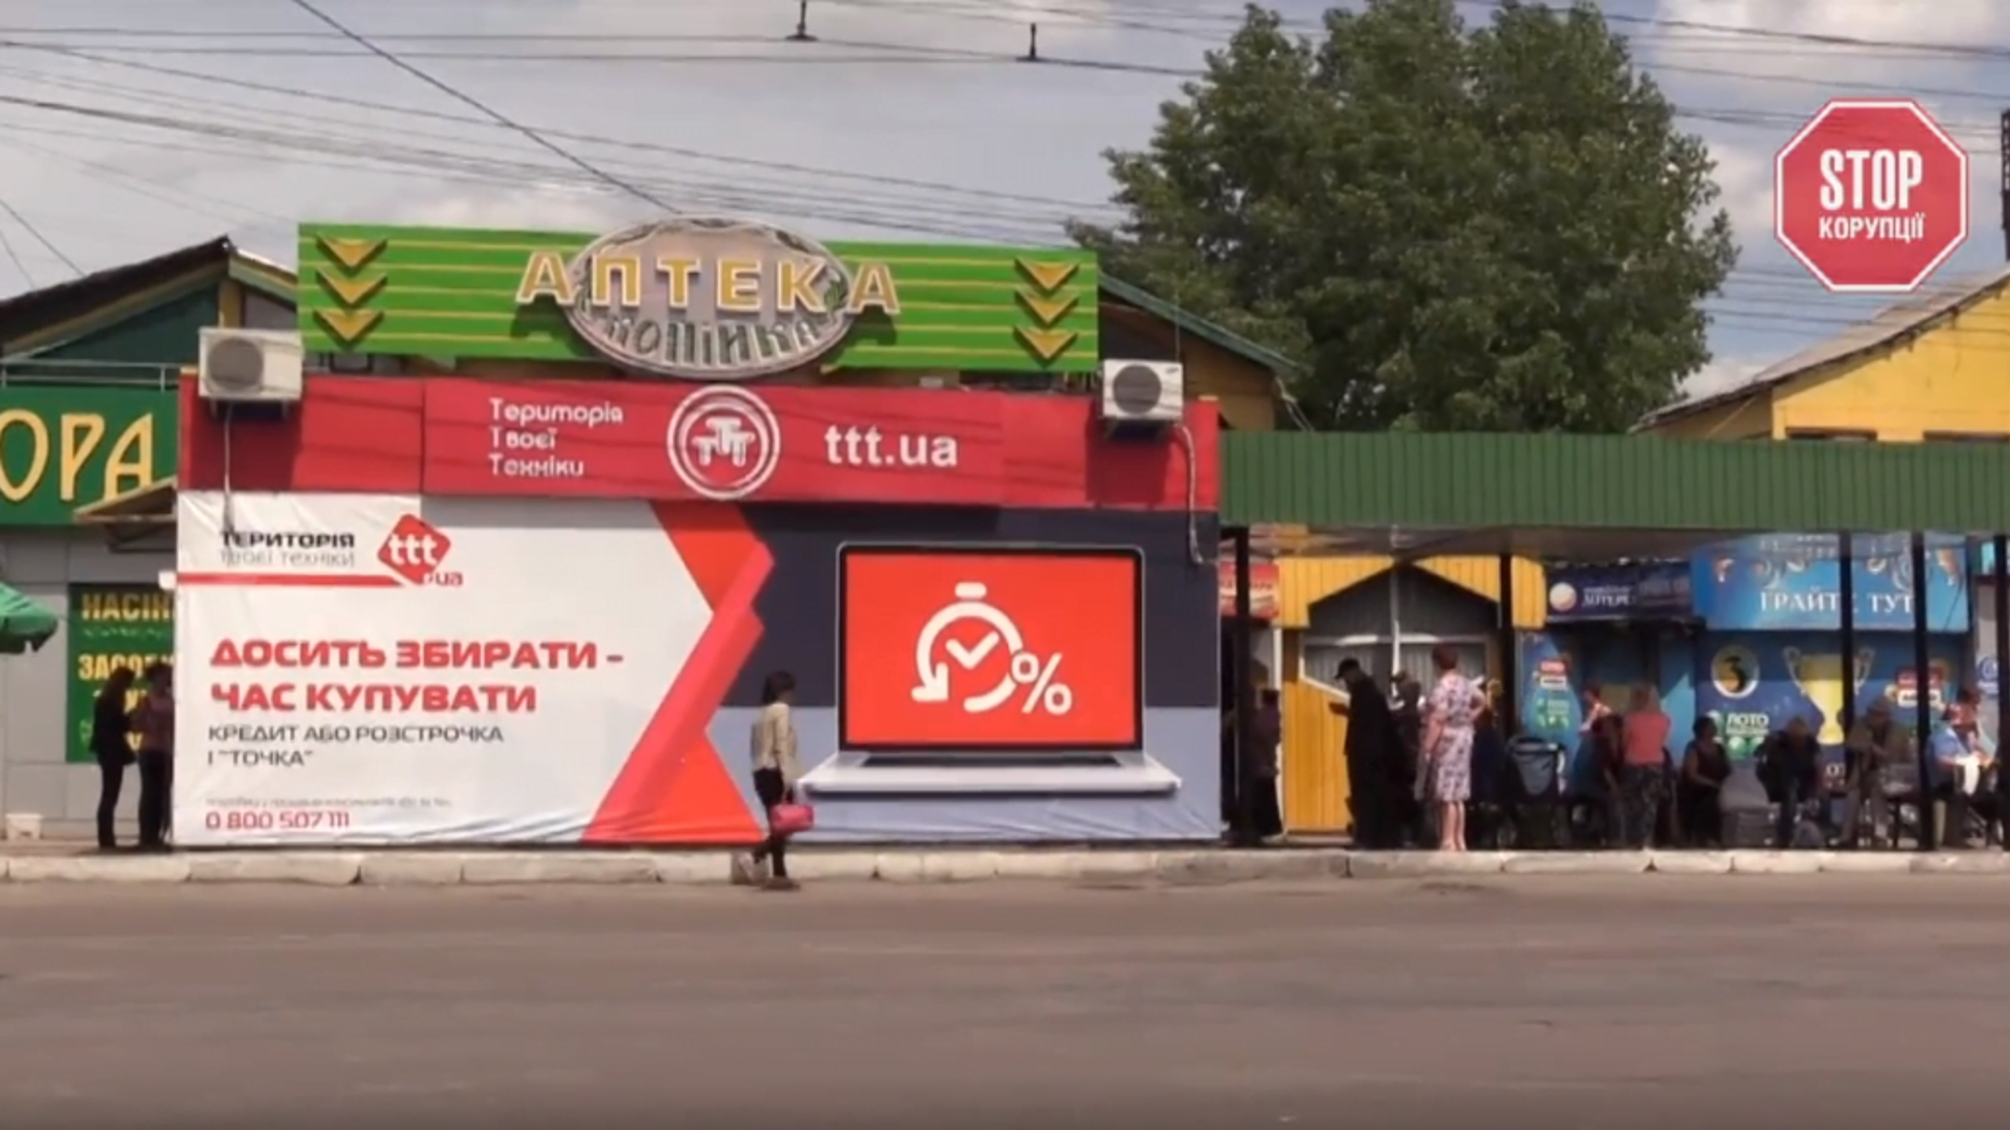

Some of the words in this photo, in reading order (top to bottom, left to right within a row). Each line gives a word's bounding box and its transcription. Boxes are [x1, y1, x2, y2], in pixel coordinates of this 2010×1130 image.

[516, 250, 900, 315] АПТЕКА
[489, 397, 623, 428] Територія
[824, 424, 958, 467] ttt.ua
[488, 453, 585, 477] Техніки
[222, 531, 355, 548] ТЕРИТОРІЯ
[387, 533, 437, 565] ttt
[1760, 586, 1858, 613] ГРАЙТ
[209, 639, 386, 668] ДОСИТЬ
[396, 641, 597, 669] ЗБИРАТИ
[210, 683, 296, 711] ЧАС
[306, 684, 537, 712] КУПУВАТИ
[208, 725, 297, 742] КРЕДИТ
[303, 725, 350, 742] АБО
[355, 725, 503, 742] РОЗСТРОЧКА
[205, 811, 221, 829] 0
[227, 811, 274, 829] 800
[279, 811, 323, 829] 507
